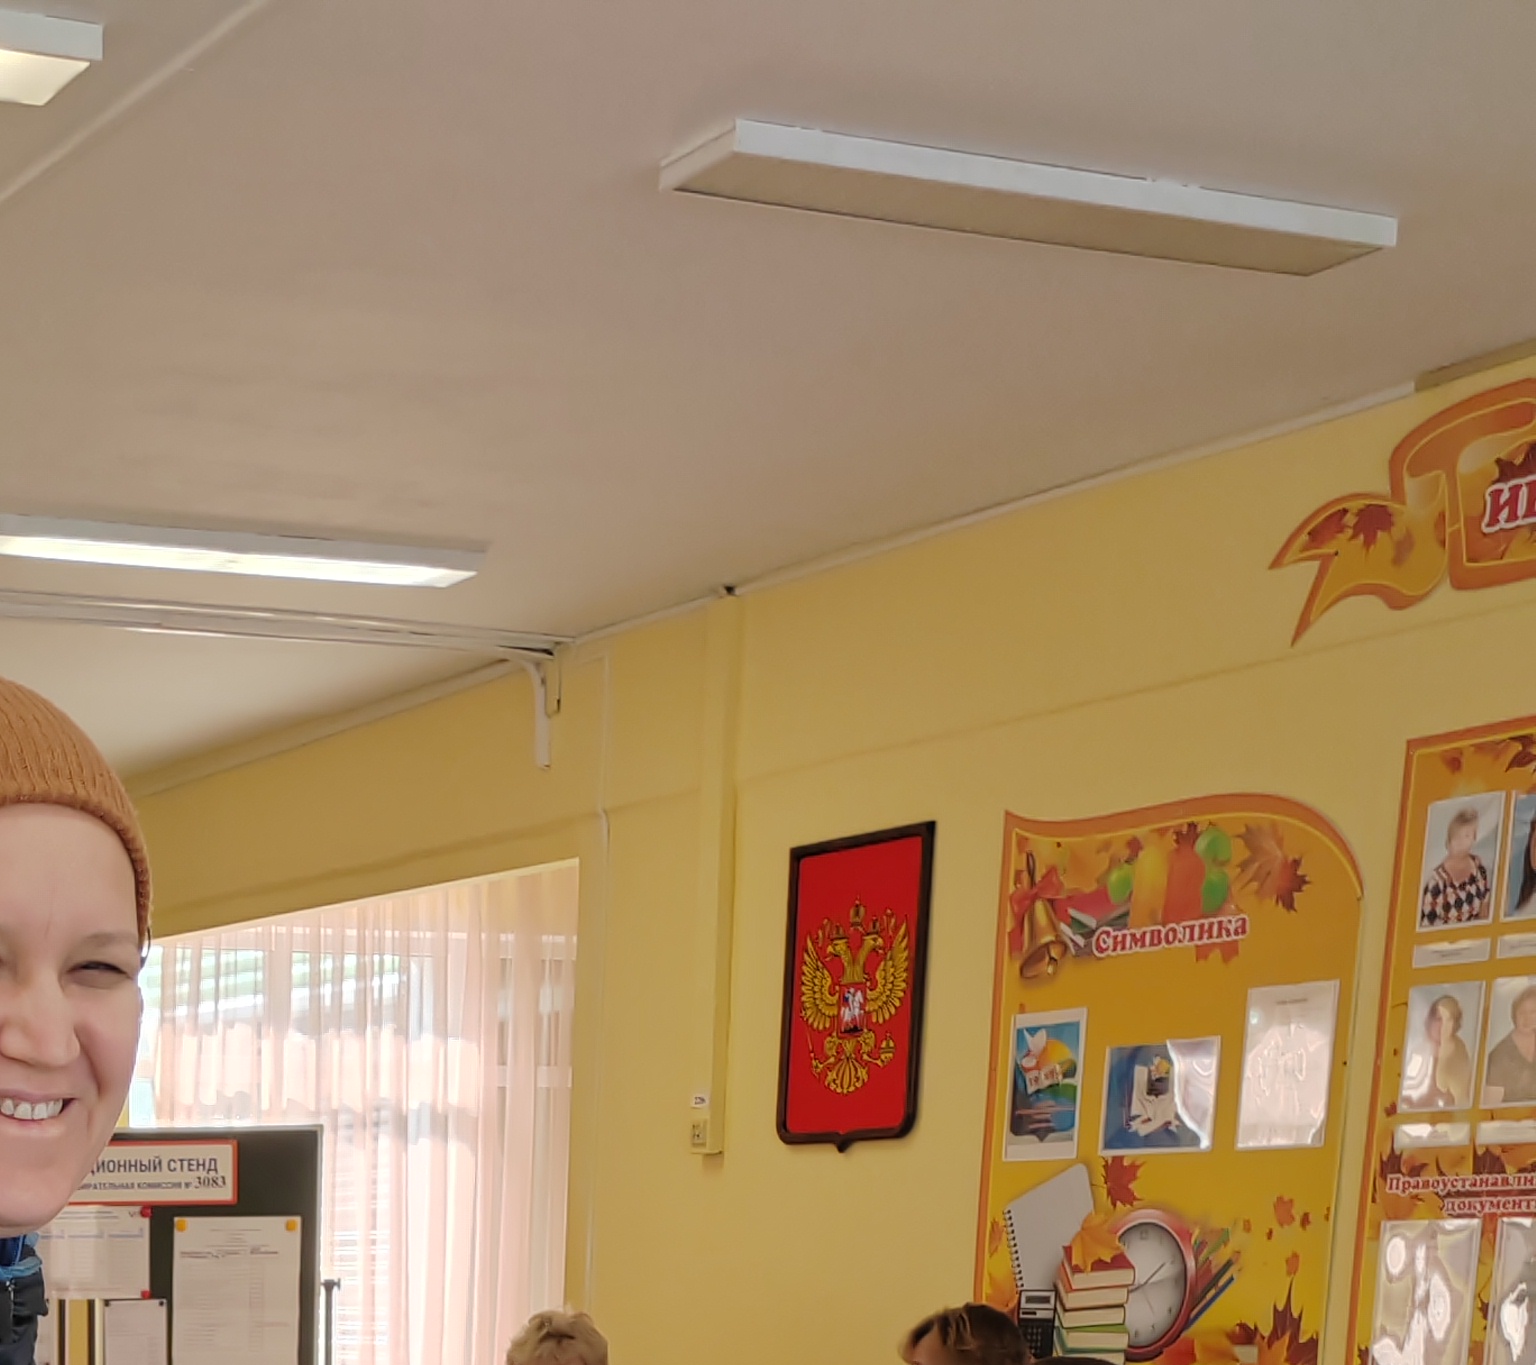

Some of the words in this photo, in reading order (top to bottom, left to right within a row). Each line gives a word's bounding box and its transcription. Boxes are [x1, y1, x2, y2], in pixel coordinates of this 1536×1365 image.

[1094, 916, 1249, 955] Символика
[91, 1156, 163, 1175] ИОННЫЙ
[167, 1158, 219, 1175] СТЕНД
[194, 1175, 227, 1190] 3083
[1445, 1198, 1536, 1215] документ
